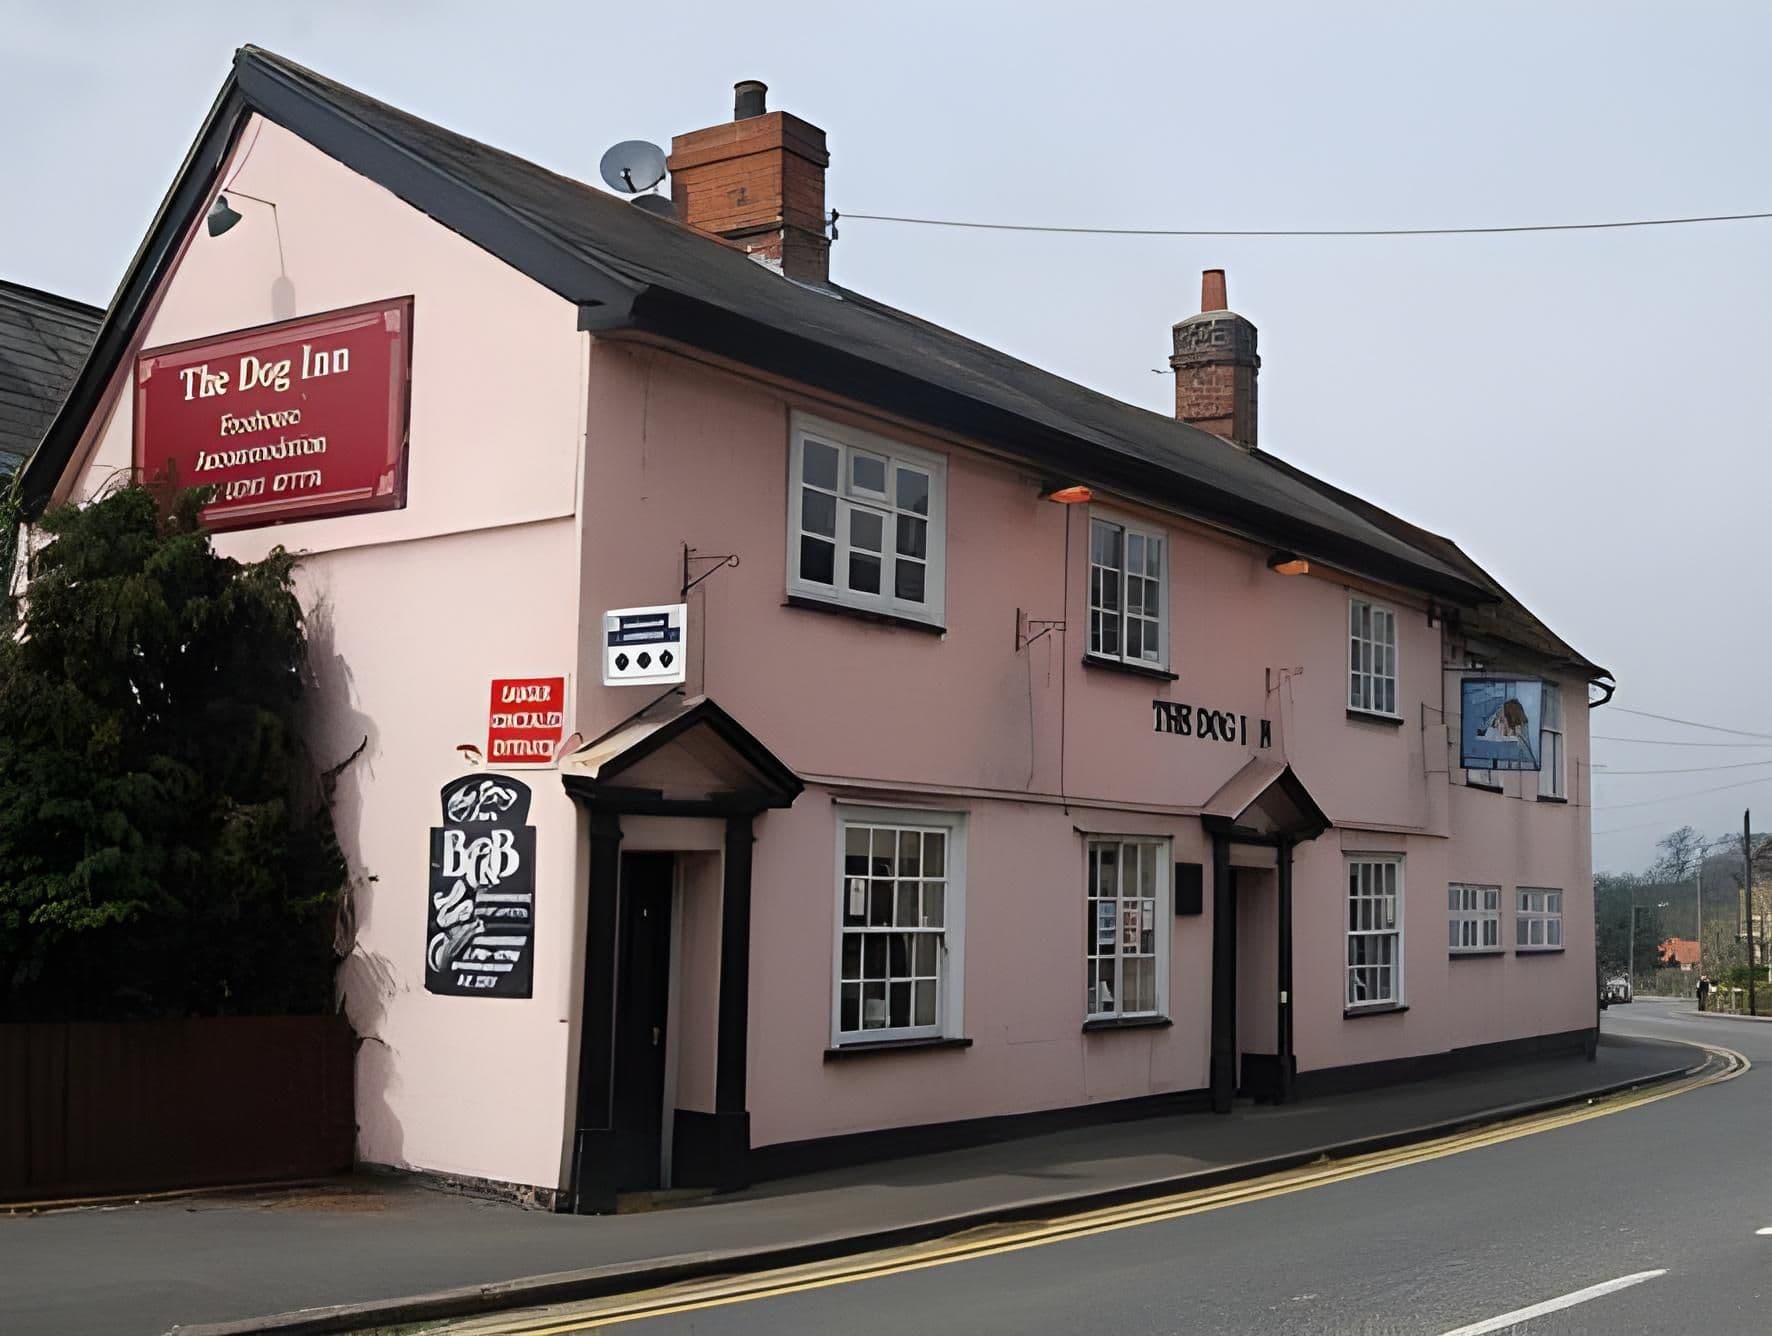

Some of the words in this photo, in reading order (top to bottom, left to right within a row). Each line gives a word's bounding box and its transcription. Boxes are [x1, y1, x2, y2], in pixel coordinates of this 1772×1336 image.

[180, 364, 230, 401] The
[238, 356, 291, 392] Dog
[302, 344, 349, 380] Inn
